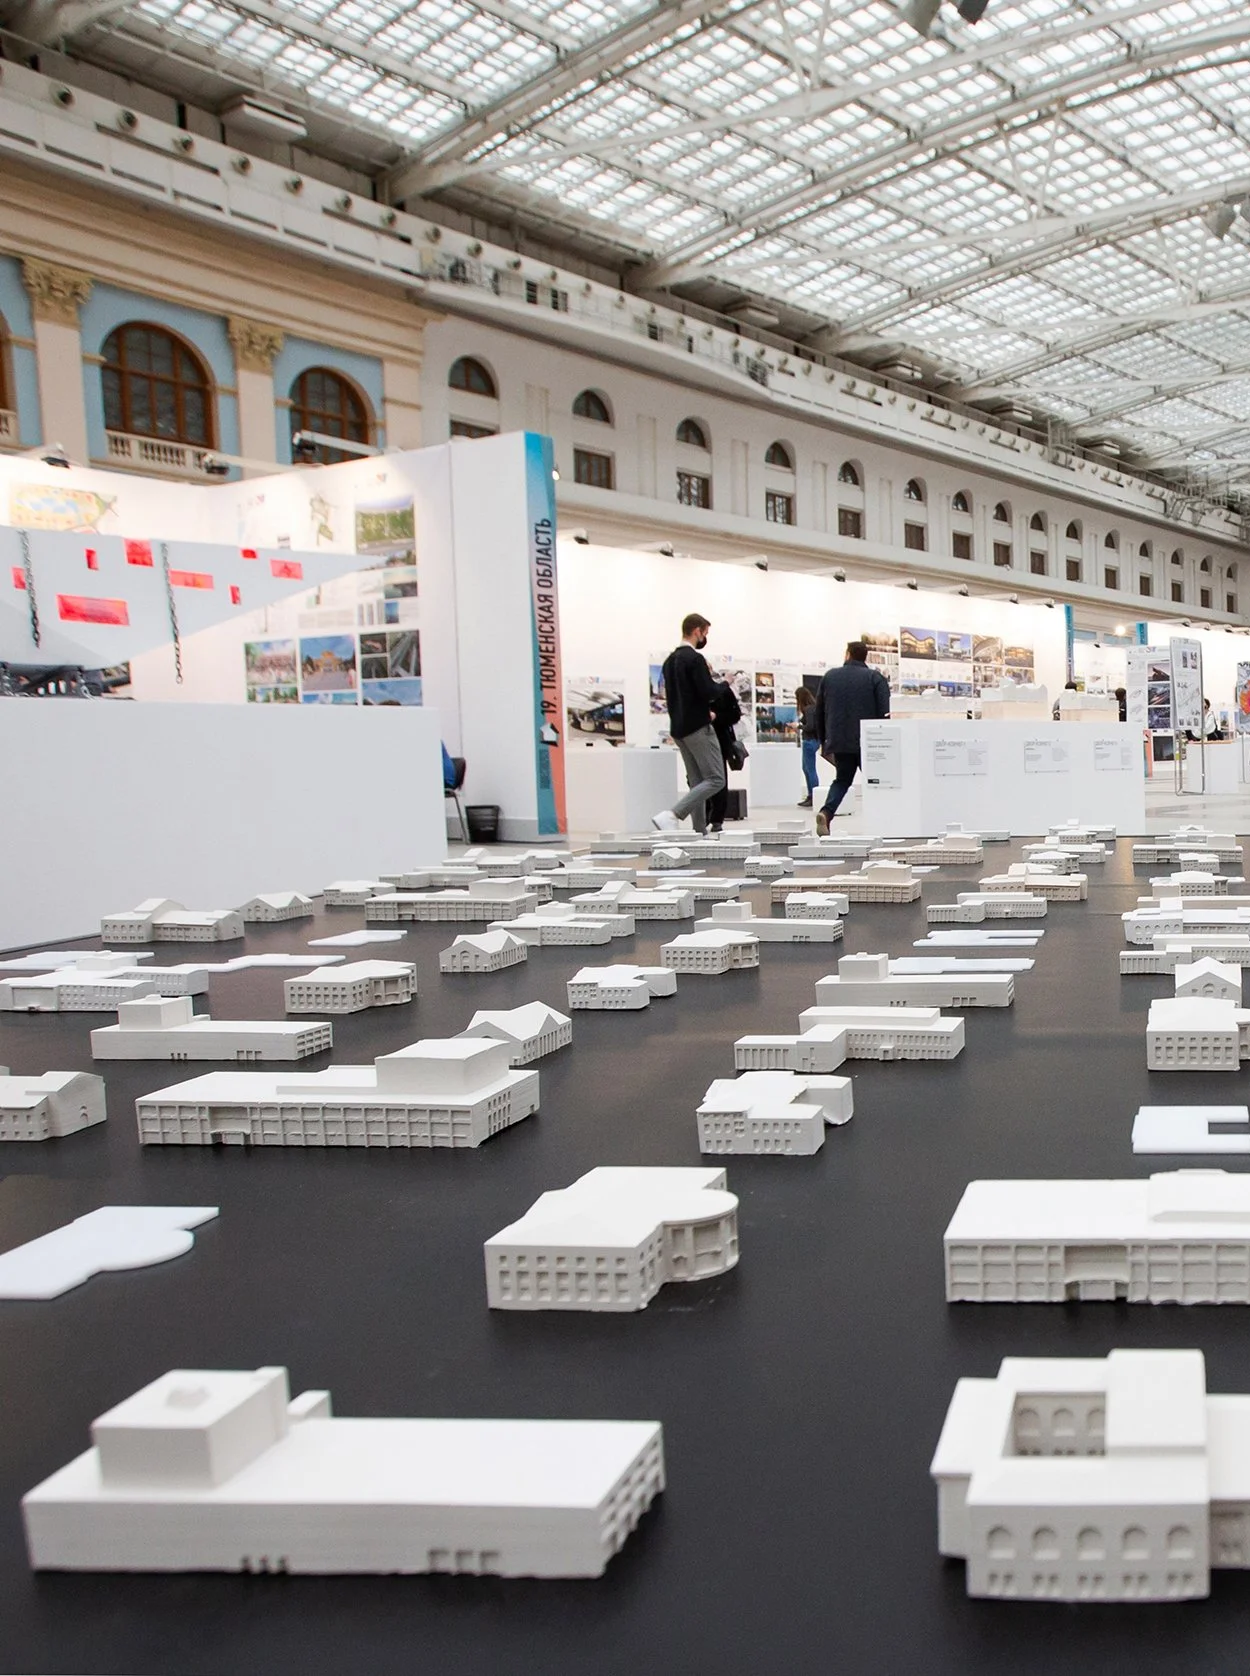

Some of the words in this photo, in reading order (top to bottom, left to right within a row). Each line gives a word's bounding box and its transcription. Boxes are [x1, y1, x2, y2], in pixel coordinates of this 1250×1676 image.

[534, 518, 553, 588] ОБЛАСТЬ
[536, 593, 557, 690] ТЮМЕНСКАЯ
[540, 696, 557, 715] 19.
